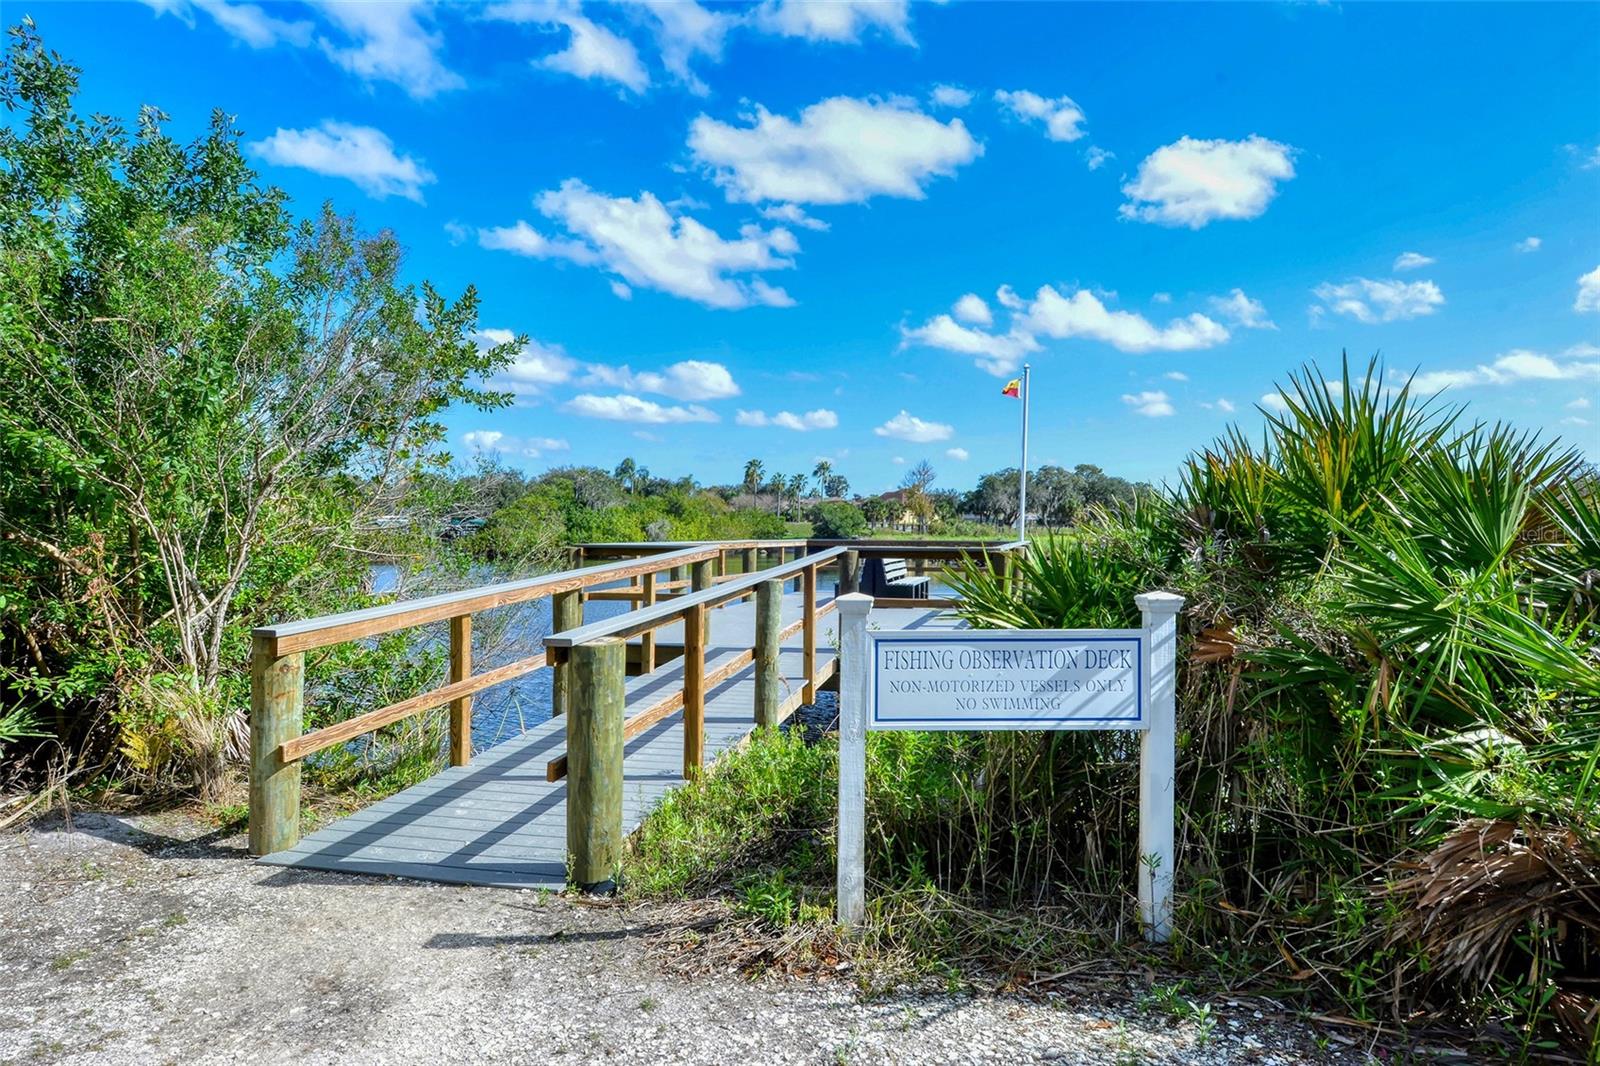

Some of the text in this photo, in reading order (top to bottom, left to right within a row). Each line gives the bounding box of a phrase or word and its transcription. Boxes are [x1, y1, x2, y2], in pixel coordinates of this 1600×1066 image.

[884, 649, 1132, 670] FISHING OBSERVATION DECK
[889, 679, 1127, 693] NON-MOTORIZED VESSELS ONLY
[956, 698, 1061, 710] NO SWIMMING
